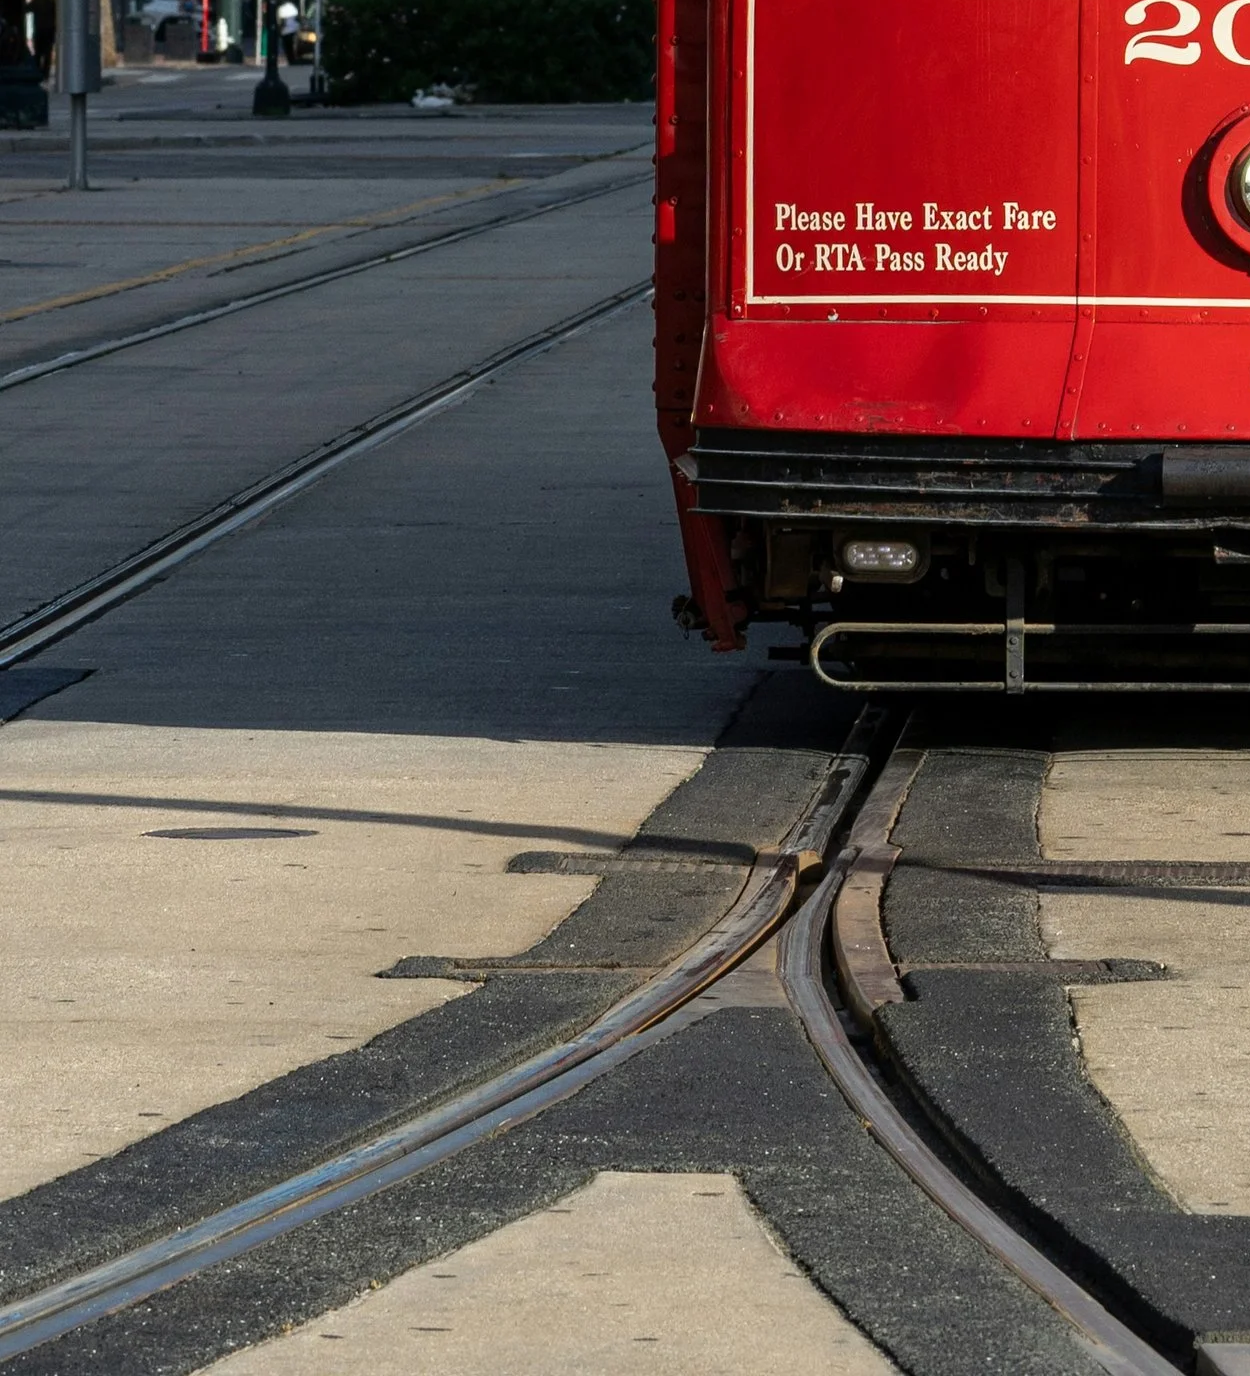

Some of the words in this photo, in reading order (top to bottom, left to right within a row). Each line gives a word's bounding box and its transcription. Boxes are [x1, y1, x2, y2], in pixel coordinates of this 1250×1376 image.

[775, 203, 846, 231] Please
[855, 203, 913, 231] Have
[923, 202, 993, 231] Exact
[1002, 202, 1057, 230] Fare
[775, 243, 805, 272] Or
[814, 243, 866, 272] RTA
[875, 243, 925, 272] Pass
[935, 243, 1008, 276] Ready
